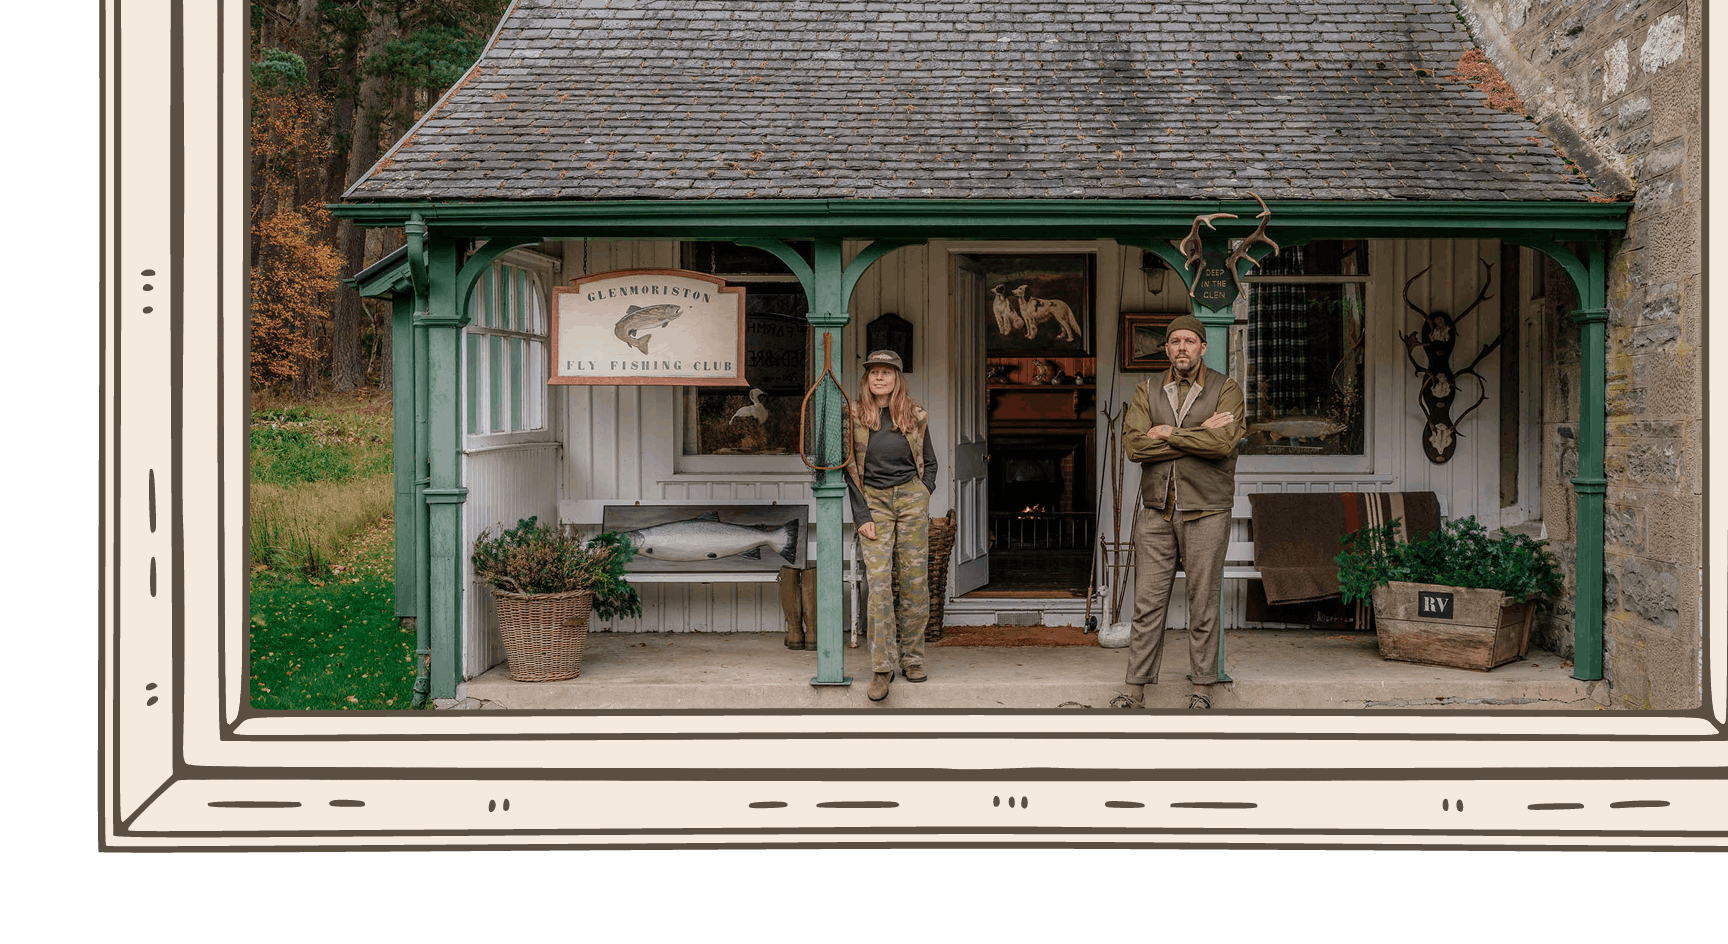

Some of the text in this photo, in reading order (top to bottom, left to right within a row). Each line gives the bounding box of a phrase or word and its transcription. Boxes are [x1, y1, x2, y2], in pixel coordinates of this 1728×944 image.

[1206, 268, 1225, 277] DEEP
[1201, 280, 1227, 288] IN THE
[587, 285, 712, 303] GLENMORISTON
[1203, 291, 1226, 299] GLEN
[567, 360, 733, 371] FLY FISHING CLUB
[1423, 596, 1449, 613] RV
